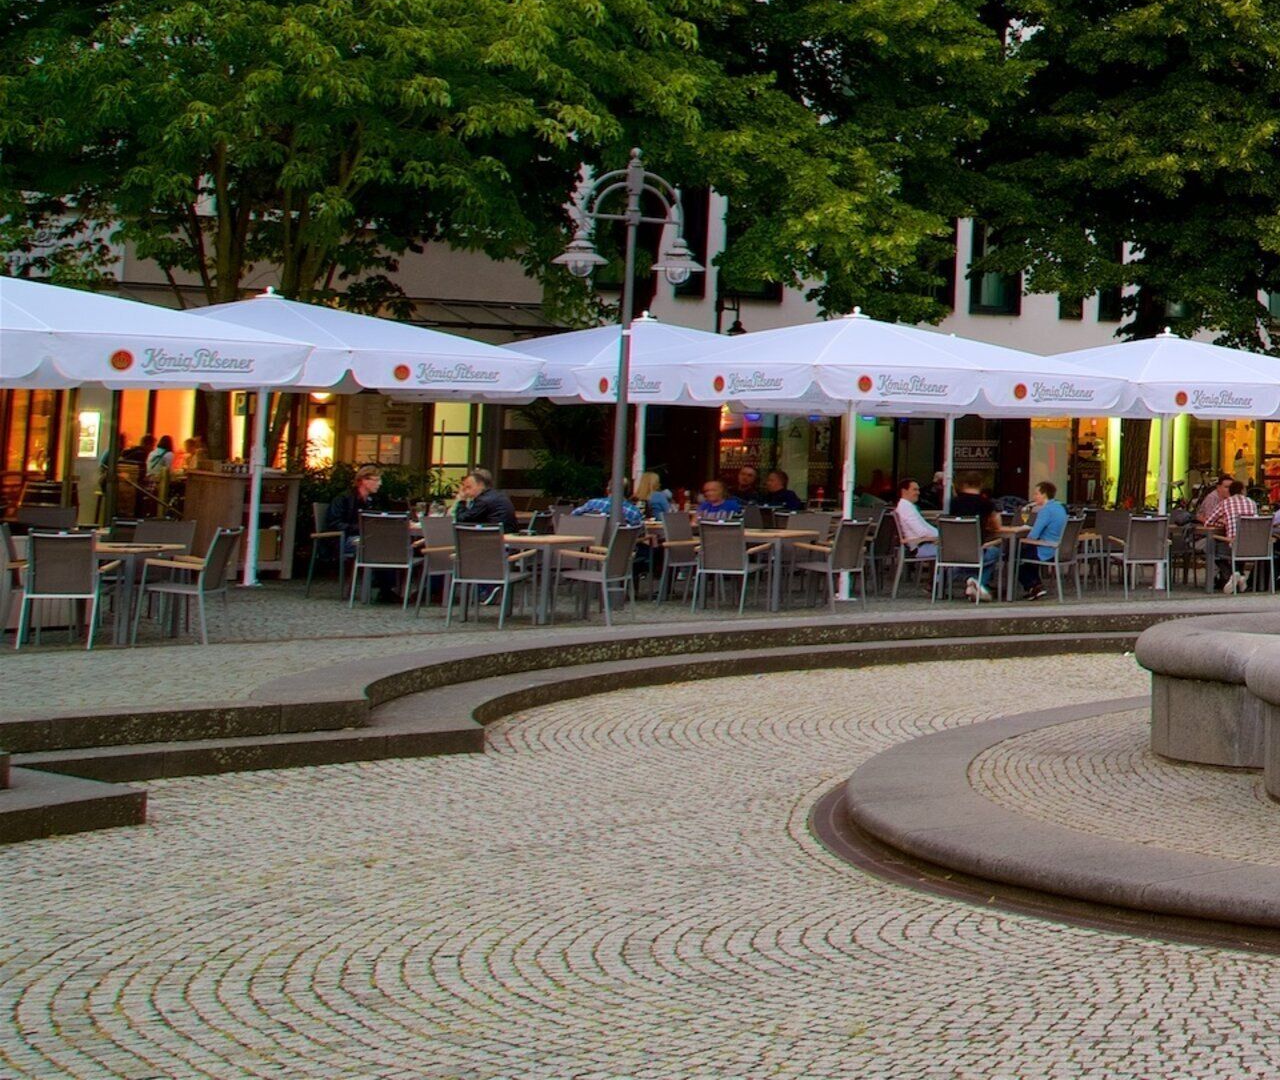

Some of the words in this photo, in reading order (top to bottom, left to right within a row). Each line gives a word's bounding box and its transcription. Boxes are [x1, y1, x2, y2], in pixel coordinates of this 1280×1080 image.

[141, 348, 193, 372] König
[193, 348, 255, 370] Pilsener
[416, 363, 454, 383] König
[454, 363, 499, 380] Pilsener
[877, 374, 910, 394] König
[908, 375, 948, 393] Pilsener
